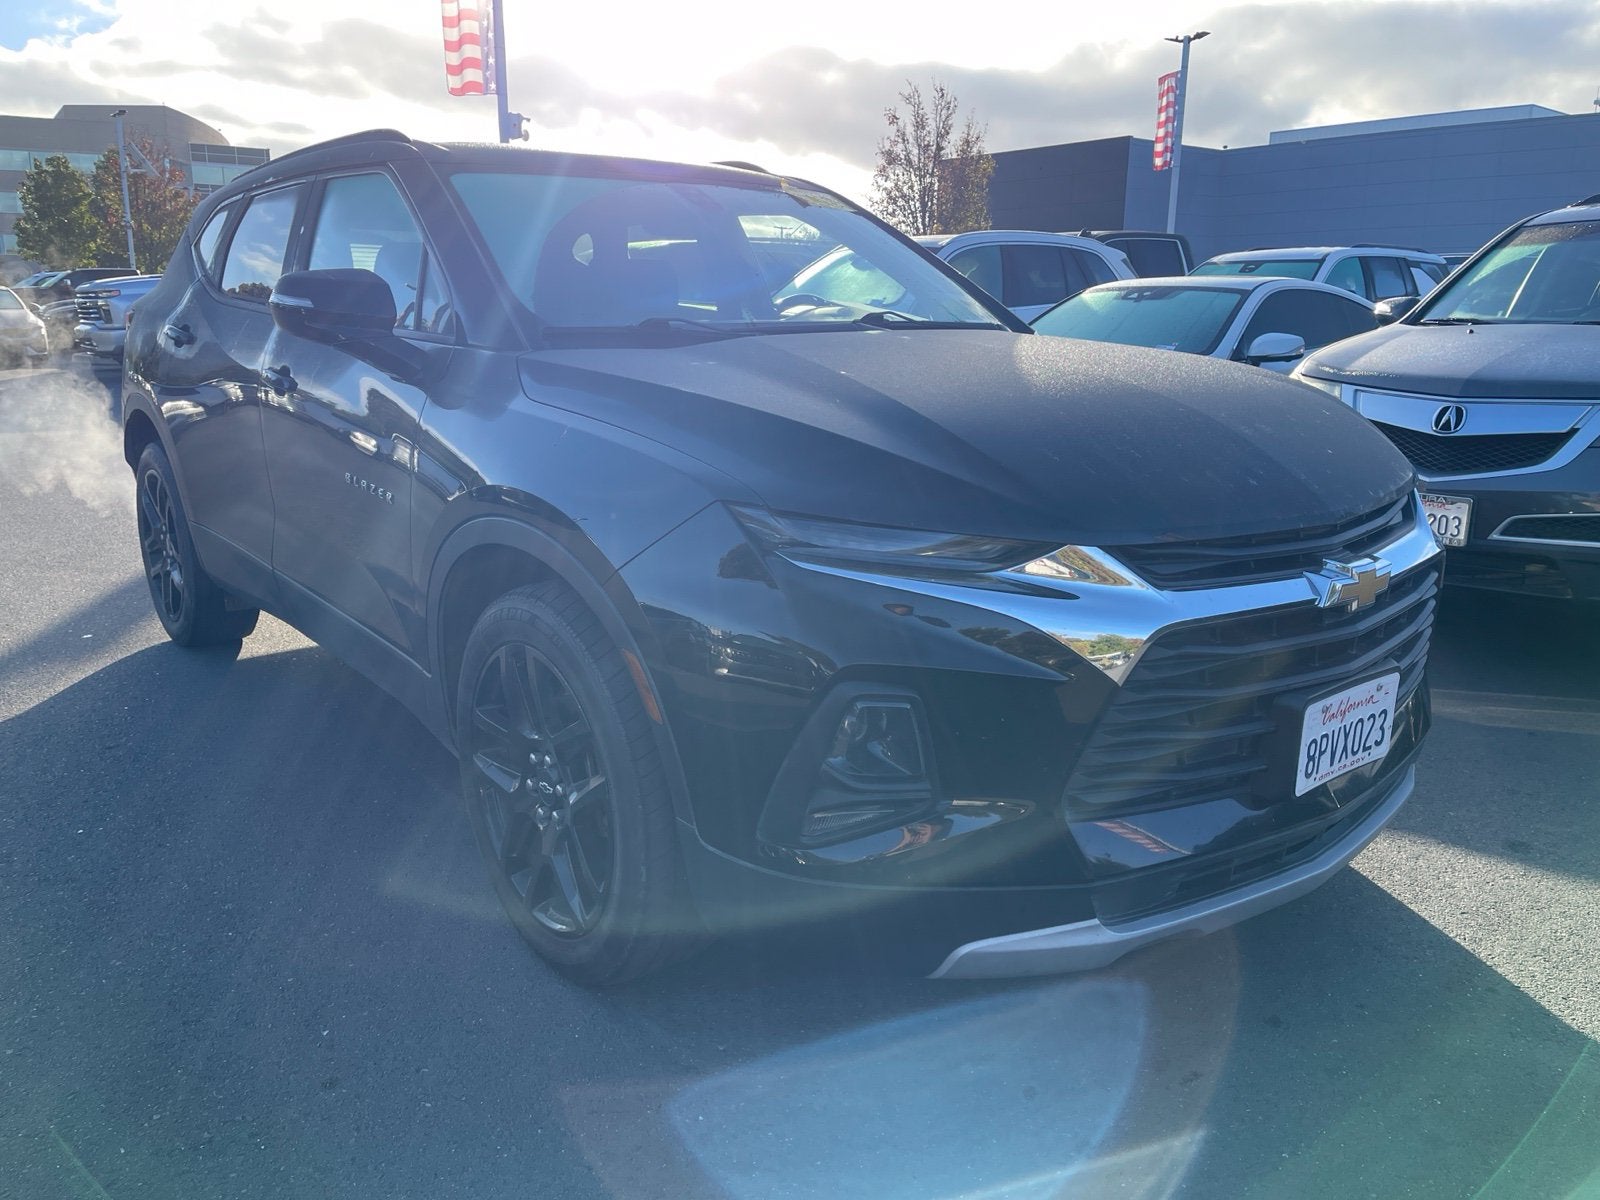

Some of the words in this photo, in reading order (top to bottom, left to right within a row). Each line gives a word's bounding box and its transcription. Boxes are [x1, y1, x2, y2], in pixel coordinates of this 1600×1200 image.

[344, 472, 393, 505] BLAZER
[1321, 691, 1380, 726] California
[1304, 708, 1388, 780] 8PVX023
